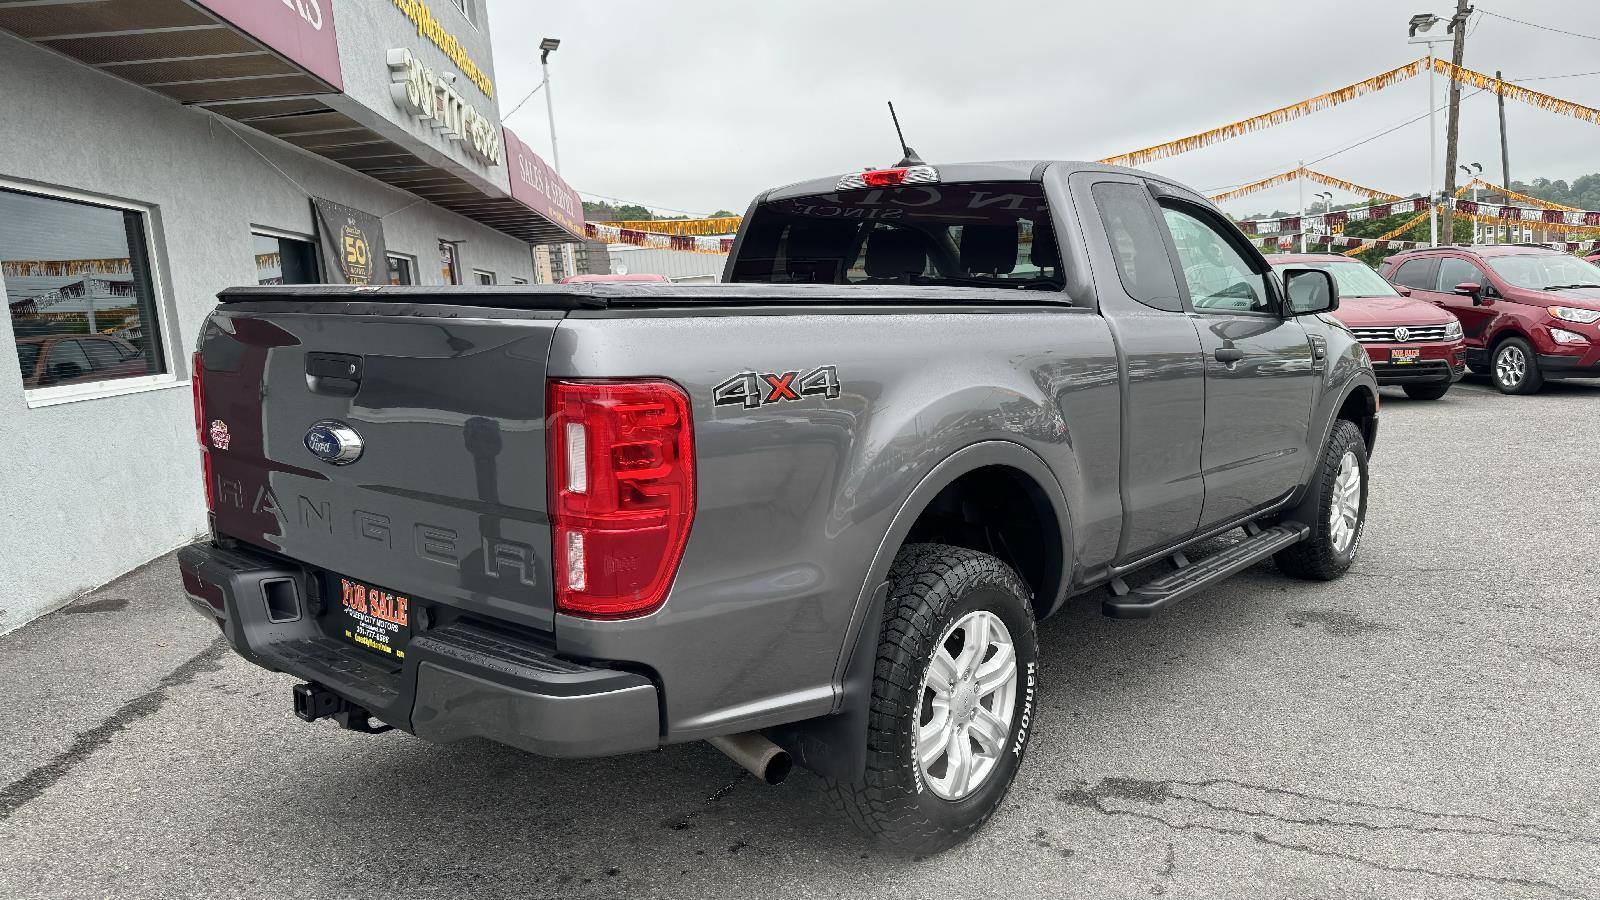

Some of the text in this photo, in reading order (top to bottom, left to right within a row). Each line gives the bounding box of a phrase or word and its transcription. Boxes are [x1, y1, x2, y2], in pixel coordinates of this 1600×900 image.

[392, 0, 493, 99] CityMotorsOnline.com
[518, 153, 544, 195] SALES
[551, 181, 575, 217] SERVICE
[345, 236, 366, 265] 50
[308, 432, 331, 453] Ford
[217, 473, 537, 586] RANGER
[341, 578, 408, 627] FOR SALE
[364, 614, 376, 625] CITY
[376, 617, 399, 633] MOTORS
